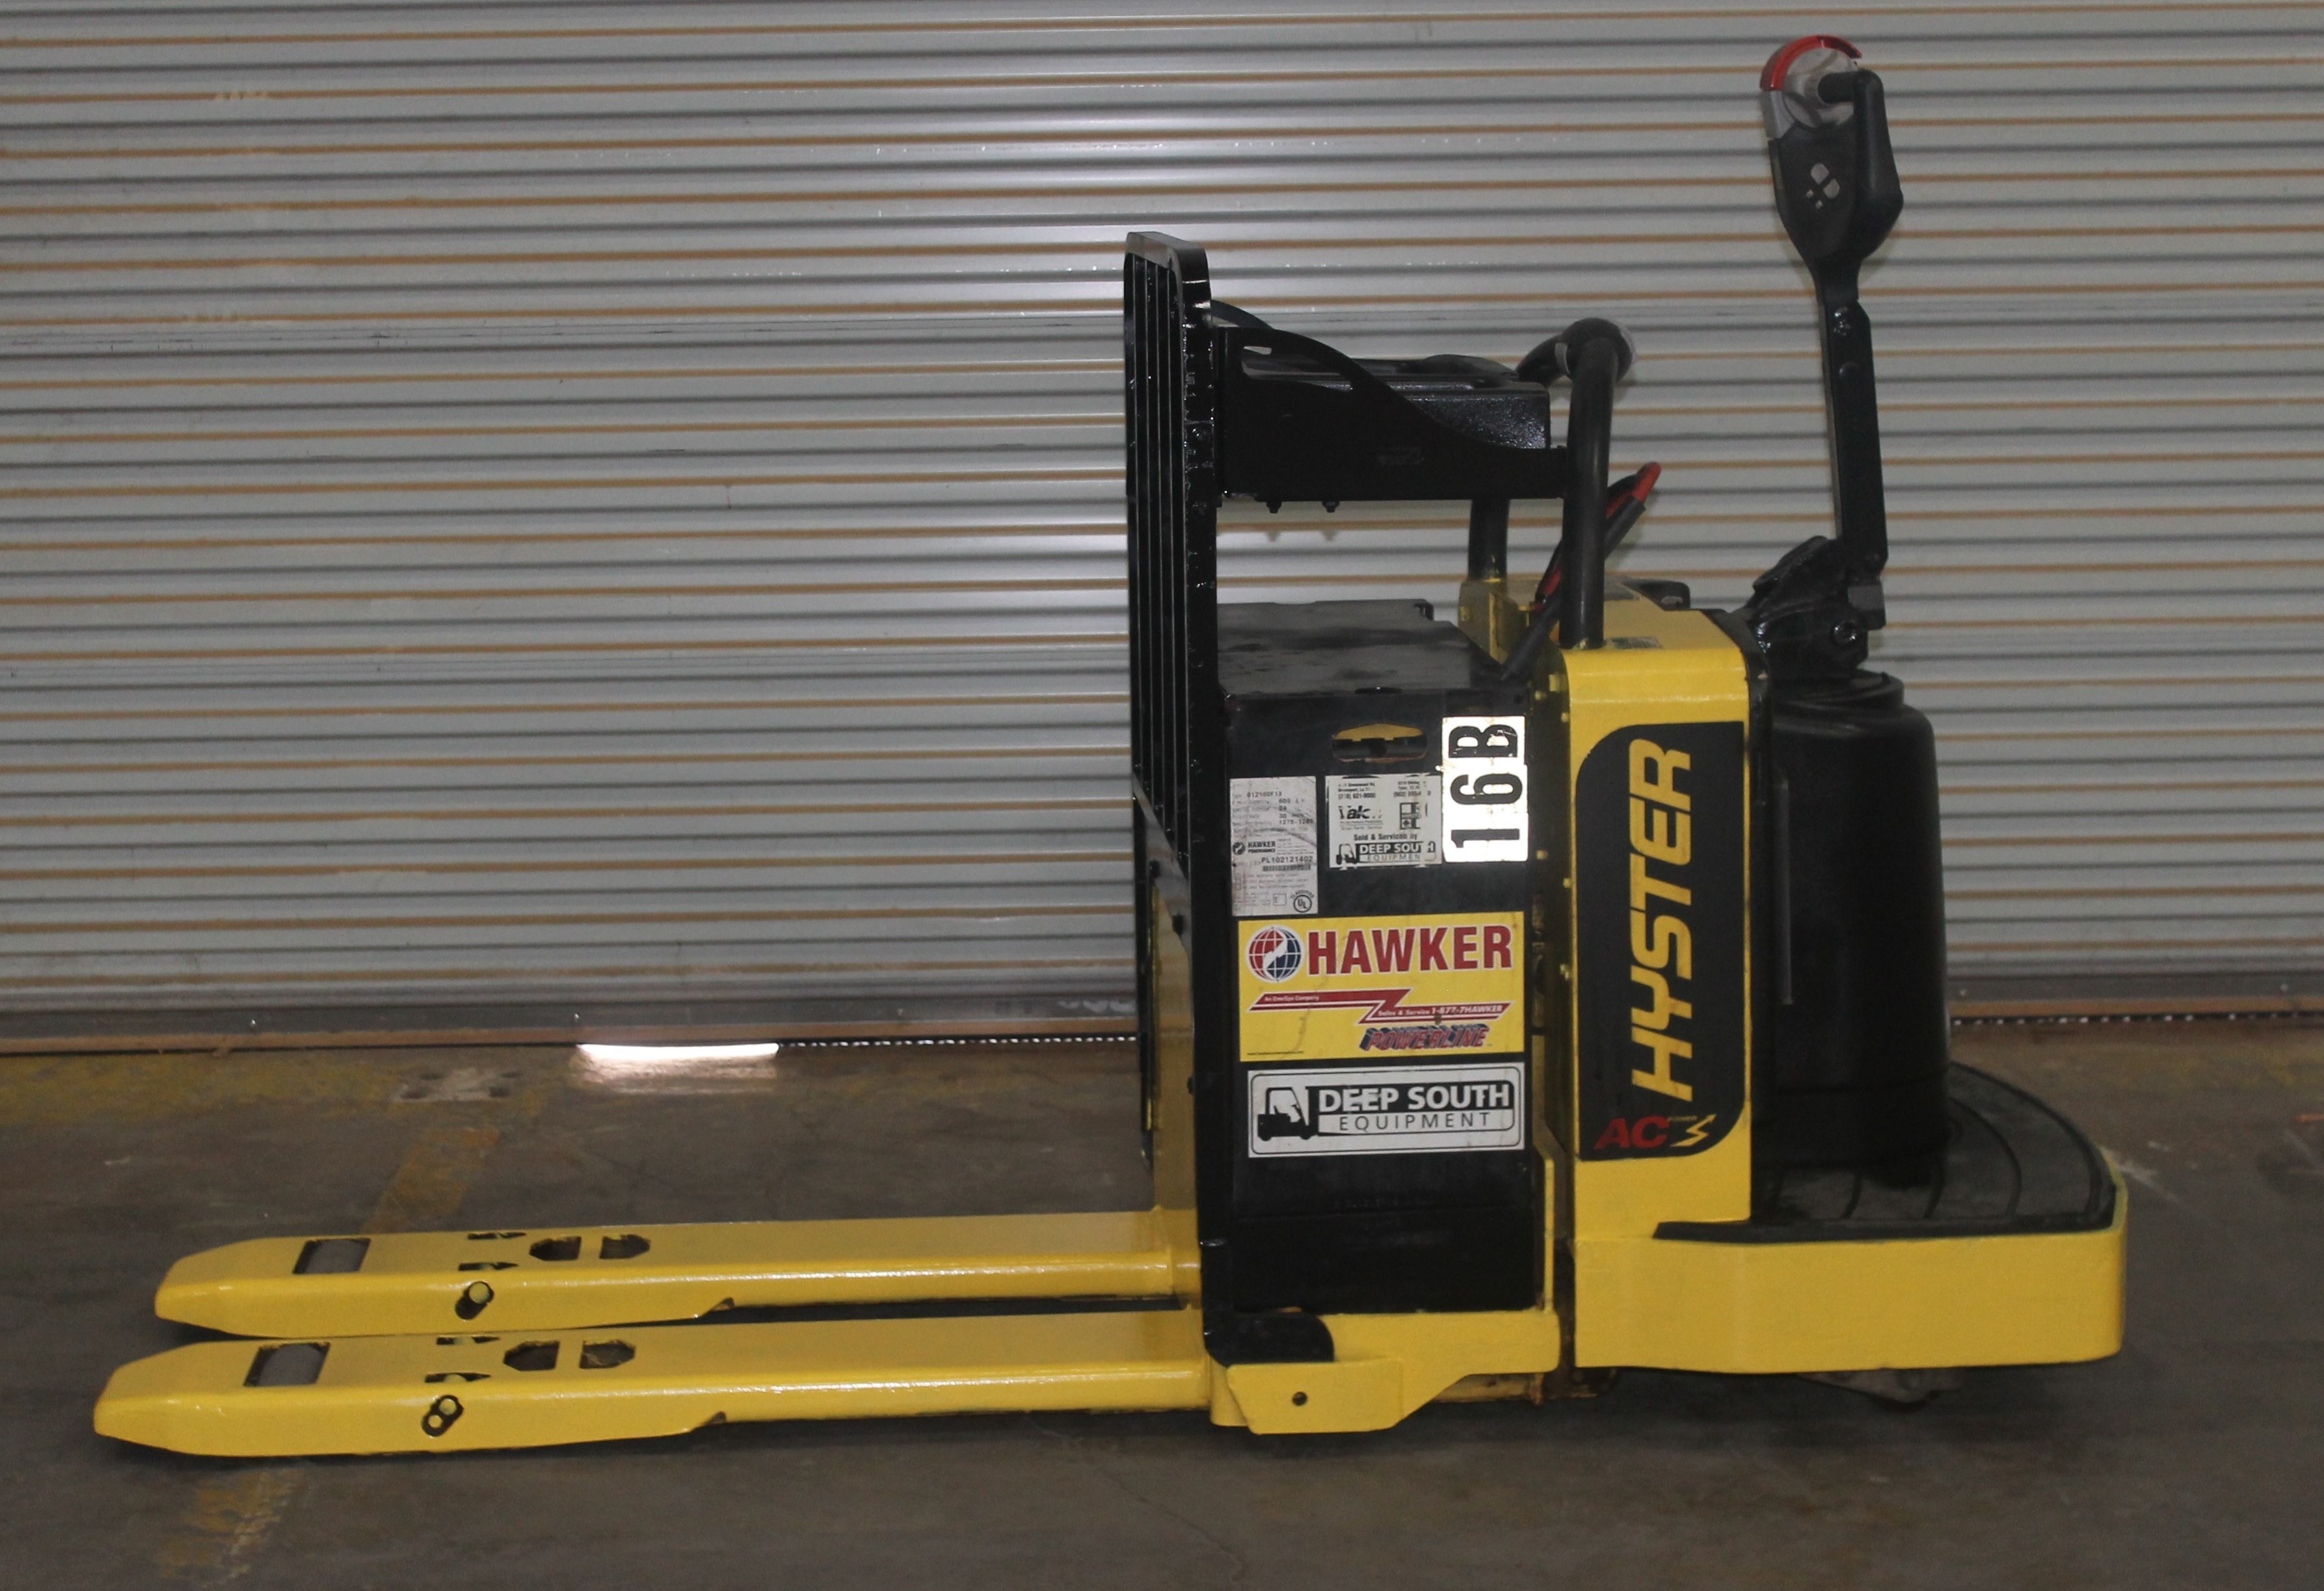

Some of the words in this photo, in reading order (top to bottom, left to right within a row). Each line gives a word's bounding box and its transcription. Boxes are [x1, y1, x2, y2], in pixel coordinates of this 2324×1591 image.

[1449, 725, 1523, 848] 16B
[1359, 844, 1391, 854] DEEP
[1629, 739, 1692, 1102] HYSTER
[1309, 924, 1512, 975] HAWKER
[1359, 1024, 1489, 1052] POWERLINE
[1319, 1087, 1399, 1113] DEEP
[1408, 1084, 1510, 1110] SOUTH
[1340, 1112, 1489, 1132] EQUIPMENT
